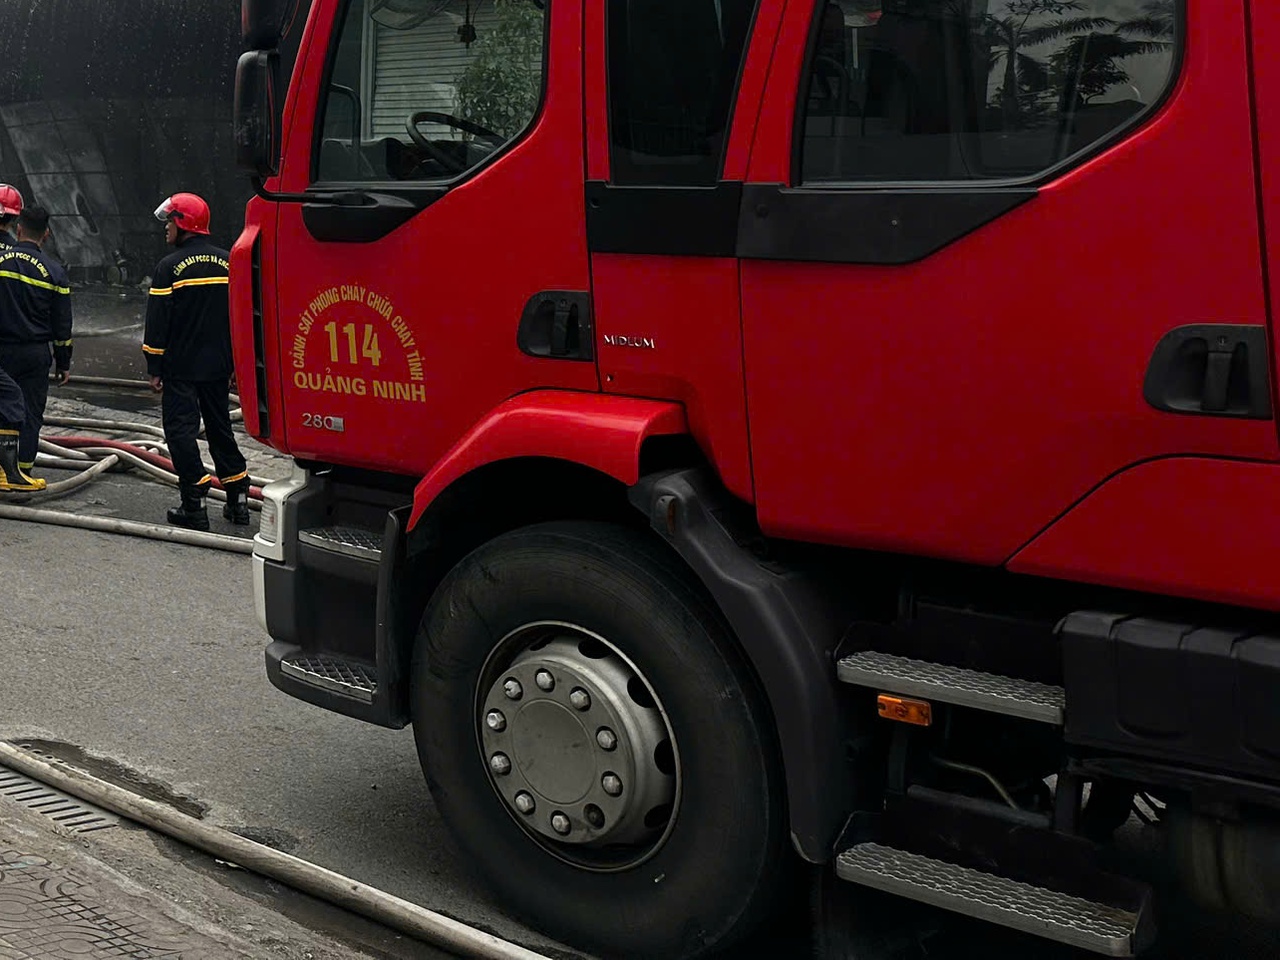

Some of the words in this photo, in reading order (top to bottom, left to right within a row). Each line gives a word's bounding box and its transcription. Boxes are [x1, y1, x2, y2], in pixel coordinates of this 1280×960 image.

[15, 252, 31, 261] PCCC
[218, 258, 229, 271] CNC
[289, 333, 307, 369] CẢNH
[298, 309, 315, 335] SÁT
[309, 287, 340, 317] PHÒNG
[340, 281, 366, 303] CHÁY
[367, 291, 394, 321] CHỮA
[391, 315, 416, 348] CHÁY
[406, 349, 426, 381] TỈNH
[324, 321, 381, 366] 114
[604, 334, 655, 349] MIDLUM
[294, 367, 366, 396] QUẢNG
[373, 380, 426, 403] NINH
